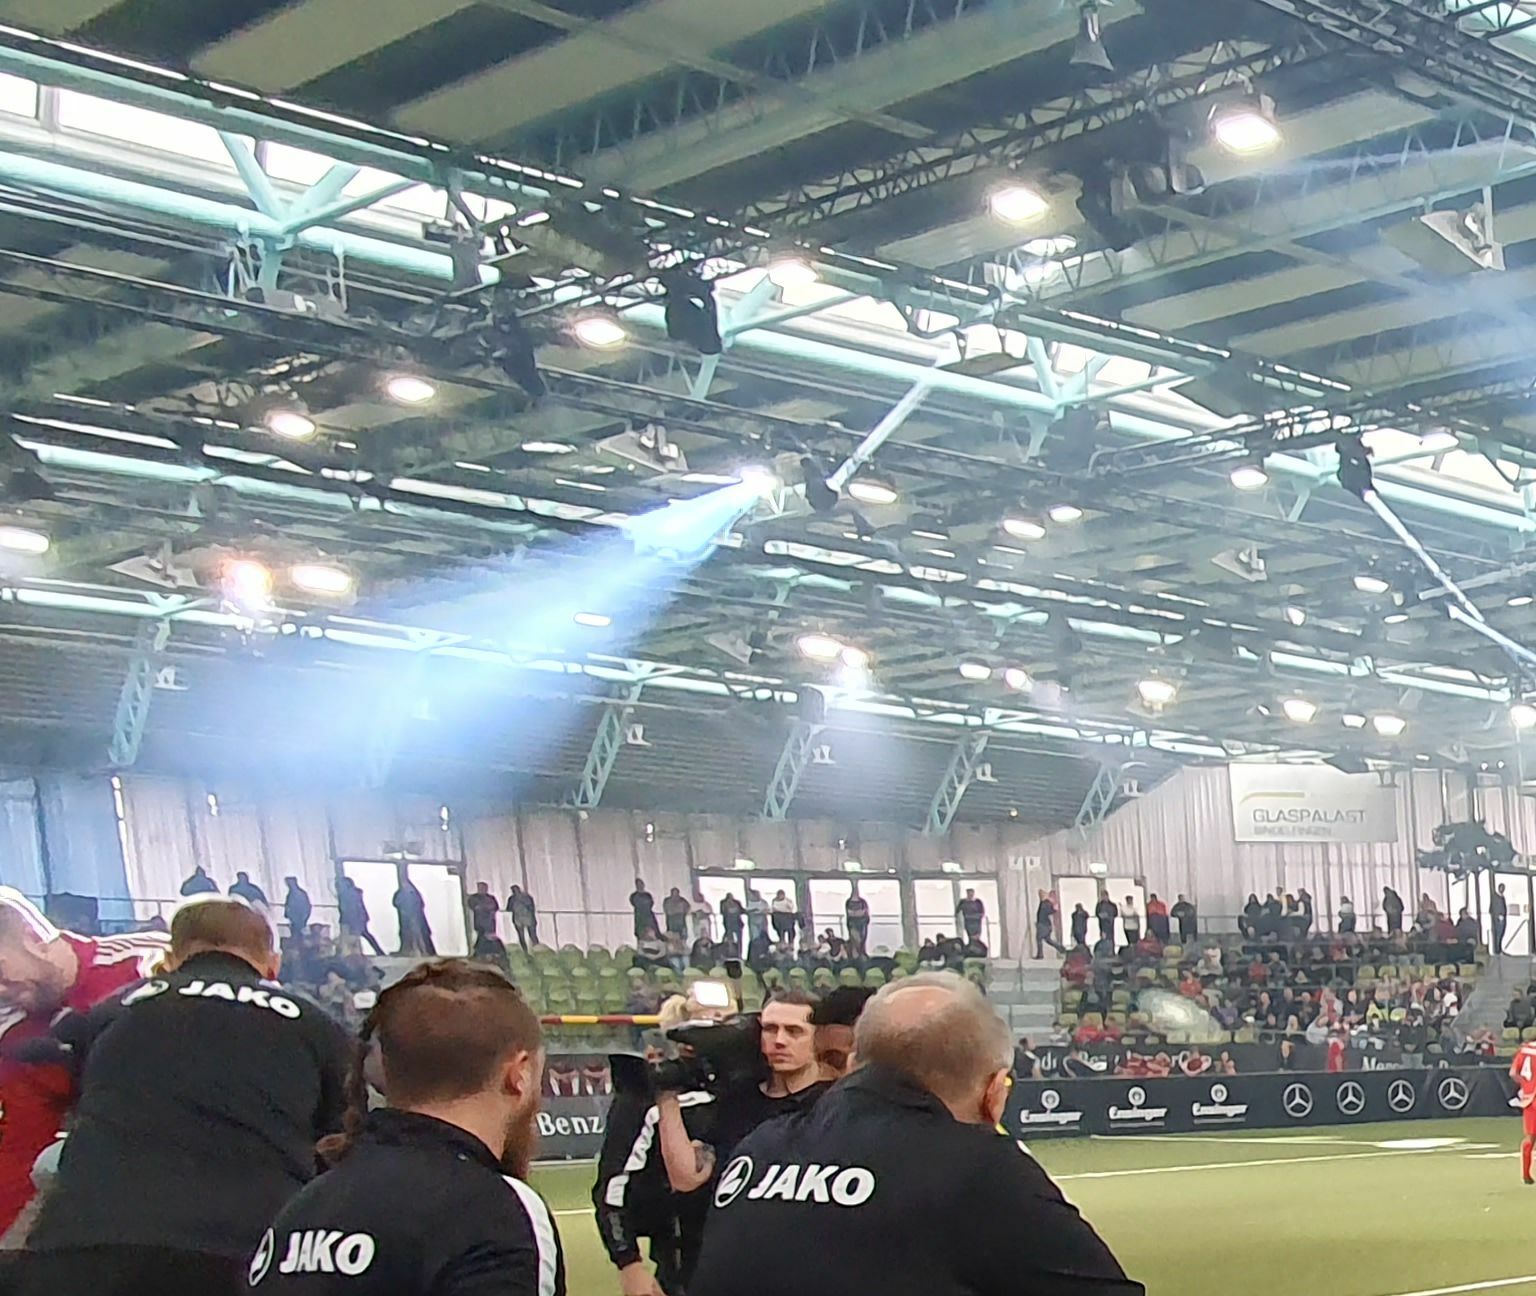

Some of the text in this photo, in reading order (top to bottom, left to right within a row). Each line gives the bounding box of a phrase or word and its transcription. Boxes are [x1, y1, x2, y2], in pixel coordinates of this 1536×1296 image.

[1253, 808, 1366, 824] GLASPALAST
[178, 980, 302, 1019] JAKO
[1520, 1056, 1533, 1081] 4
[535, 1112, 604, 1138] Benz
[747, 1163, 876, 1207] JAKO
[279, 1228, 376, 1276] JAKO
